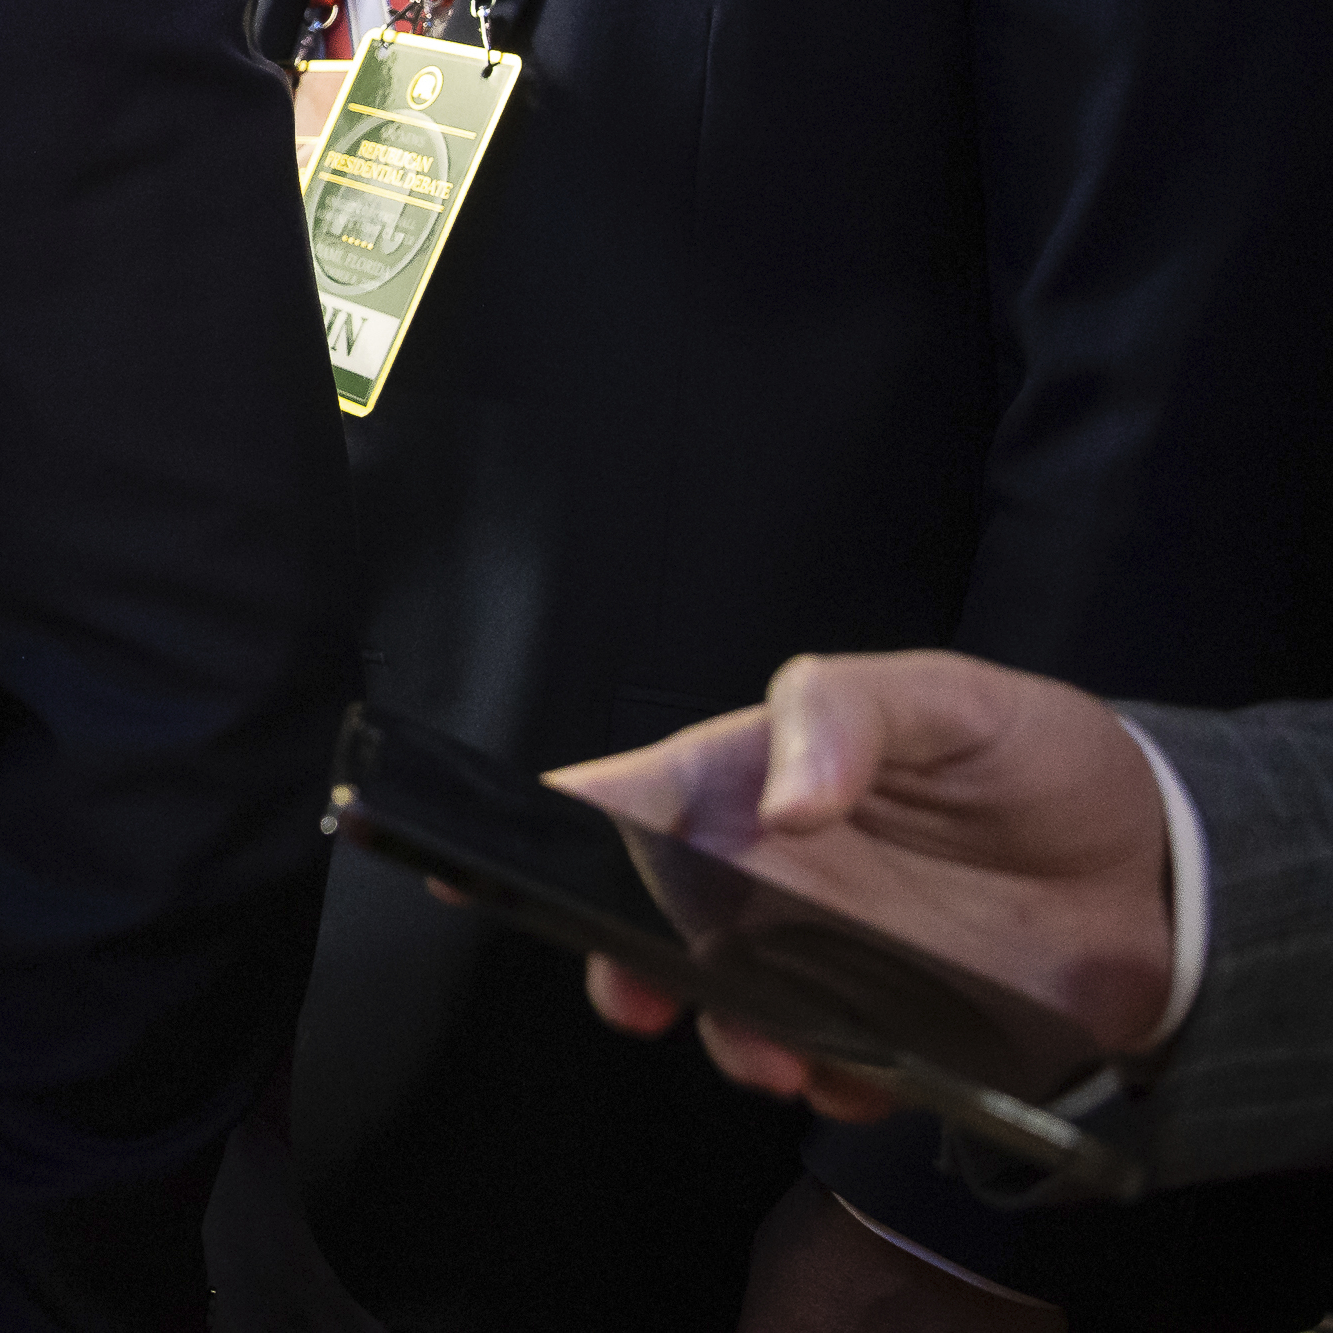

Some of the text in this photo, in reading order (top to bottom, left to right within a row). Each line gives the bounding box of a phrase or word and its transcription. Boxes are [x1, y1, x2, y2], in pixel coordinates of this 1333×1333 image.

[323, 150, 454, 200] PRESIDENTIAL DEBATE
[357, 139, 434, 174] REPUBLICAN
